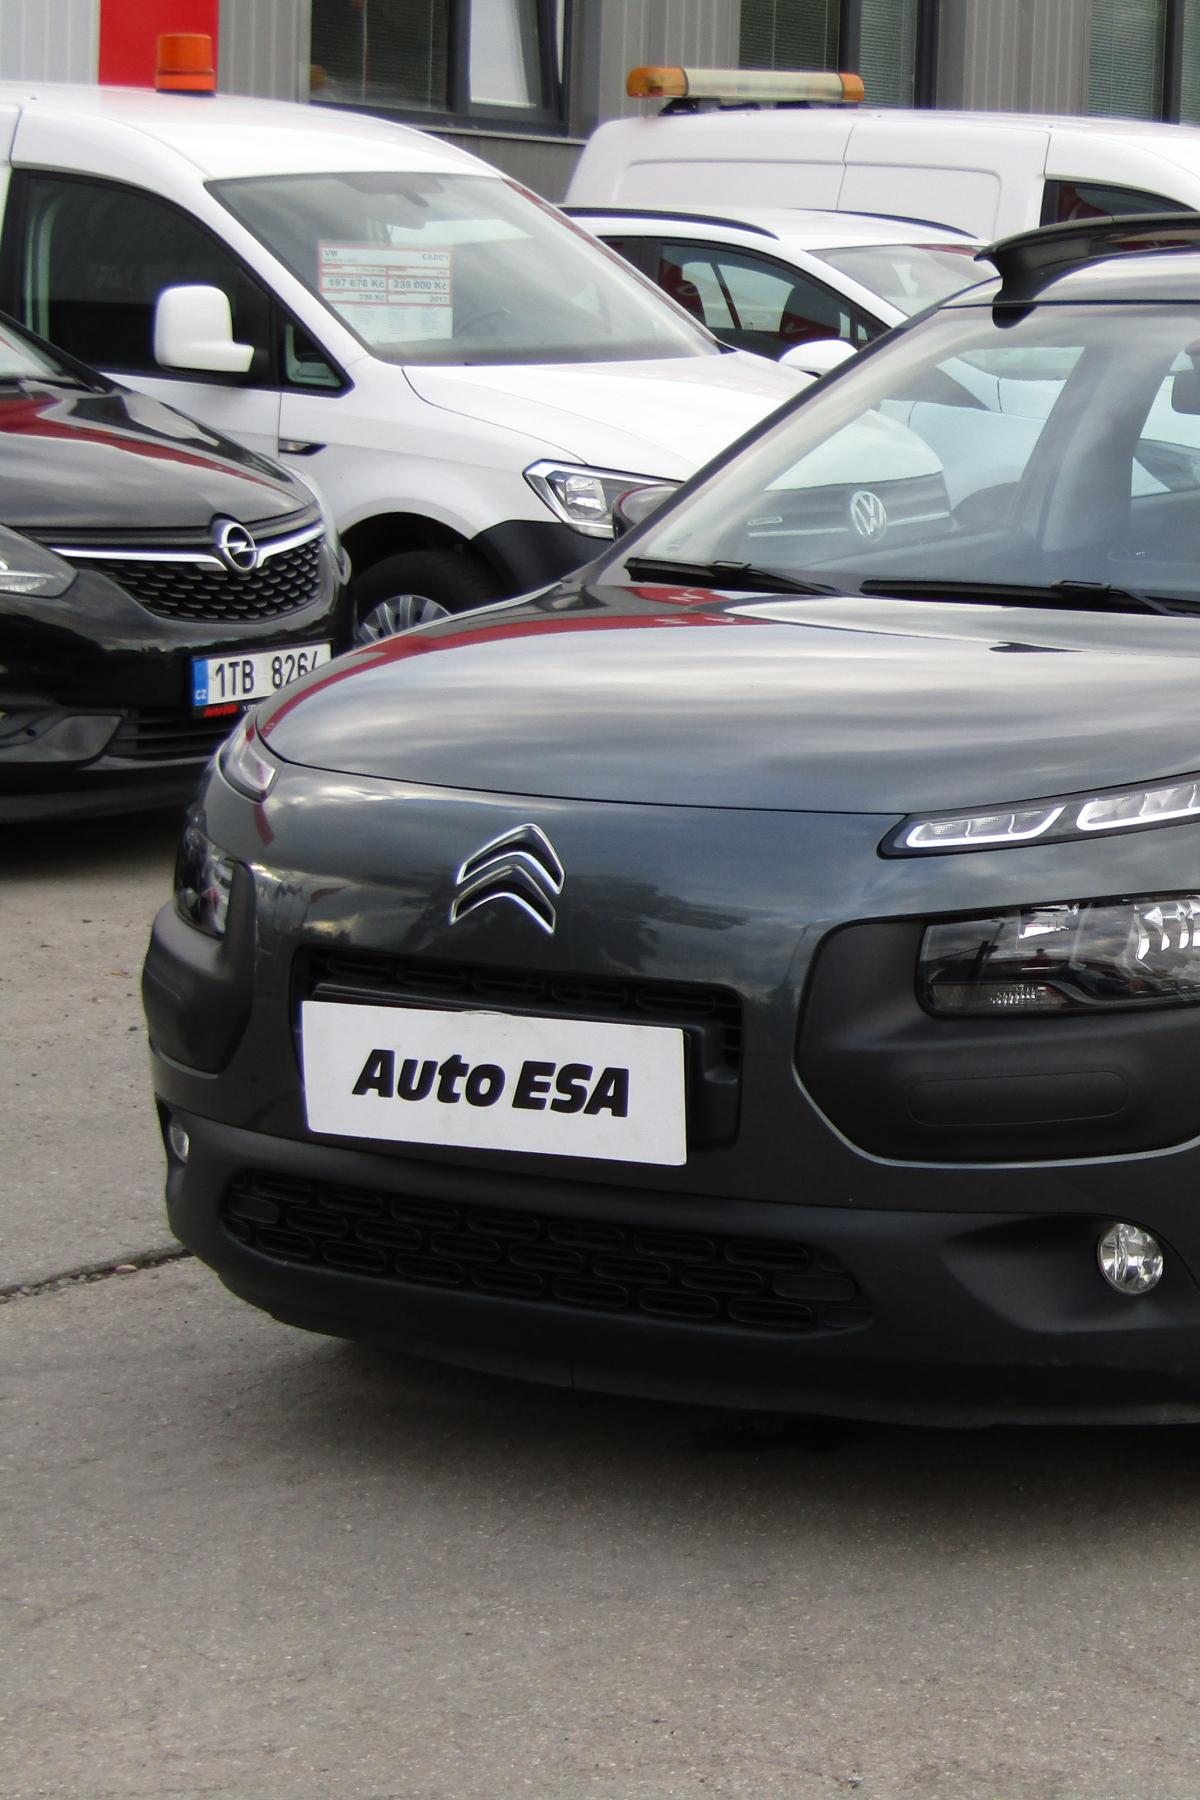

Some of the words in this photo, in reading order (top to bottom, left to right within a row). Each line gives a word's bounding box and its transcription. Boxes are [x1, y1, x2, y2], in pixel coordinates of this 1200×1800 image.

[195, 688, 208, 700] CZ
[215, 660, 254, 697] 1TB
[352, 1049, 506, 1107] Auto
[511, 1060, 630, 1118] ESA
